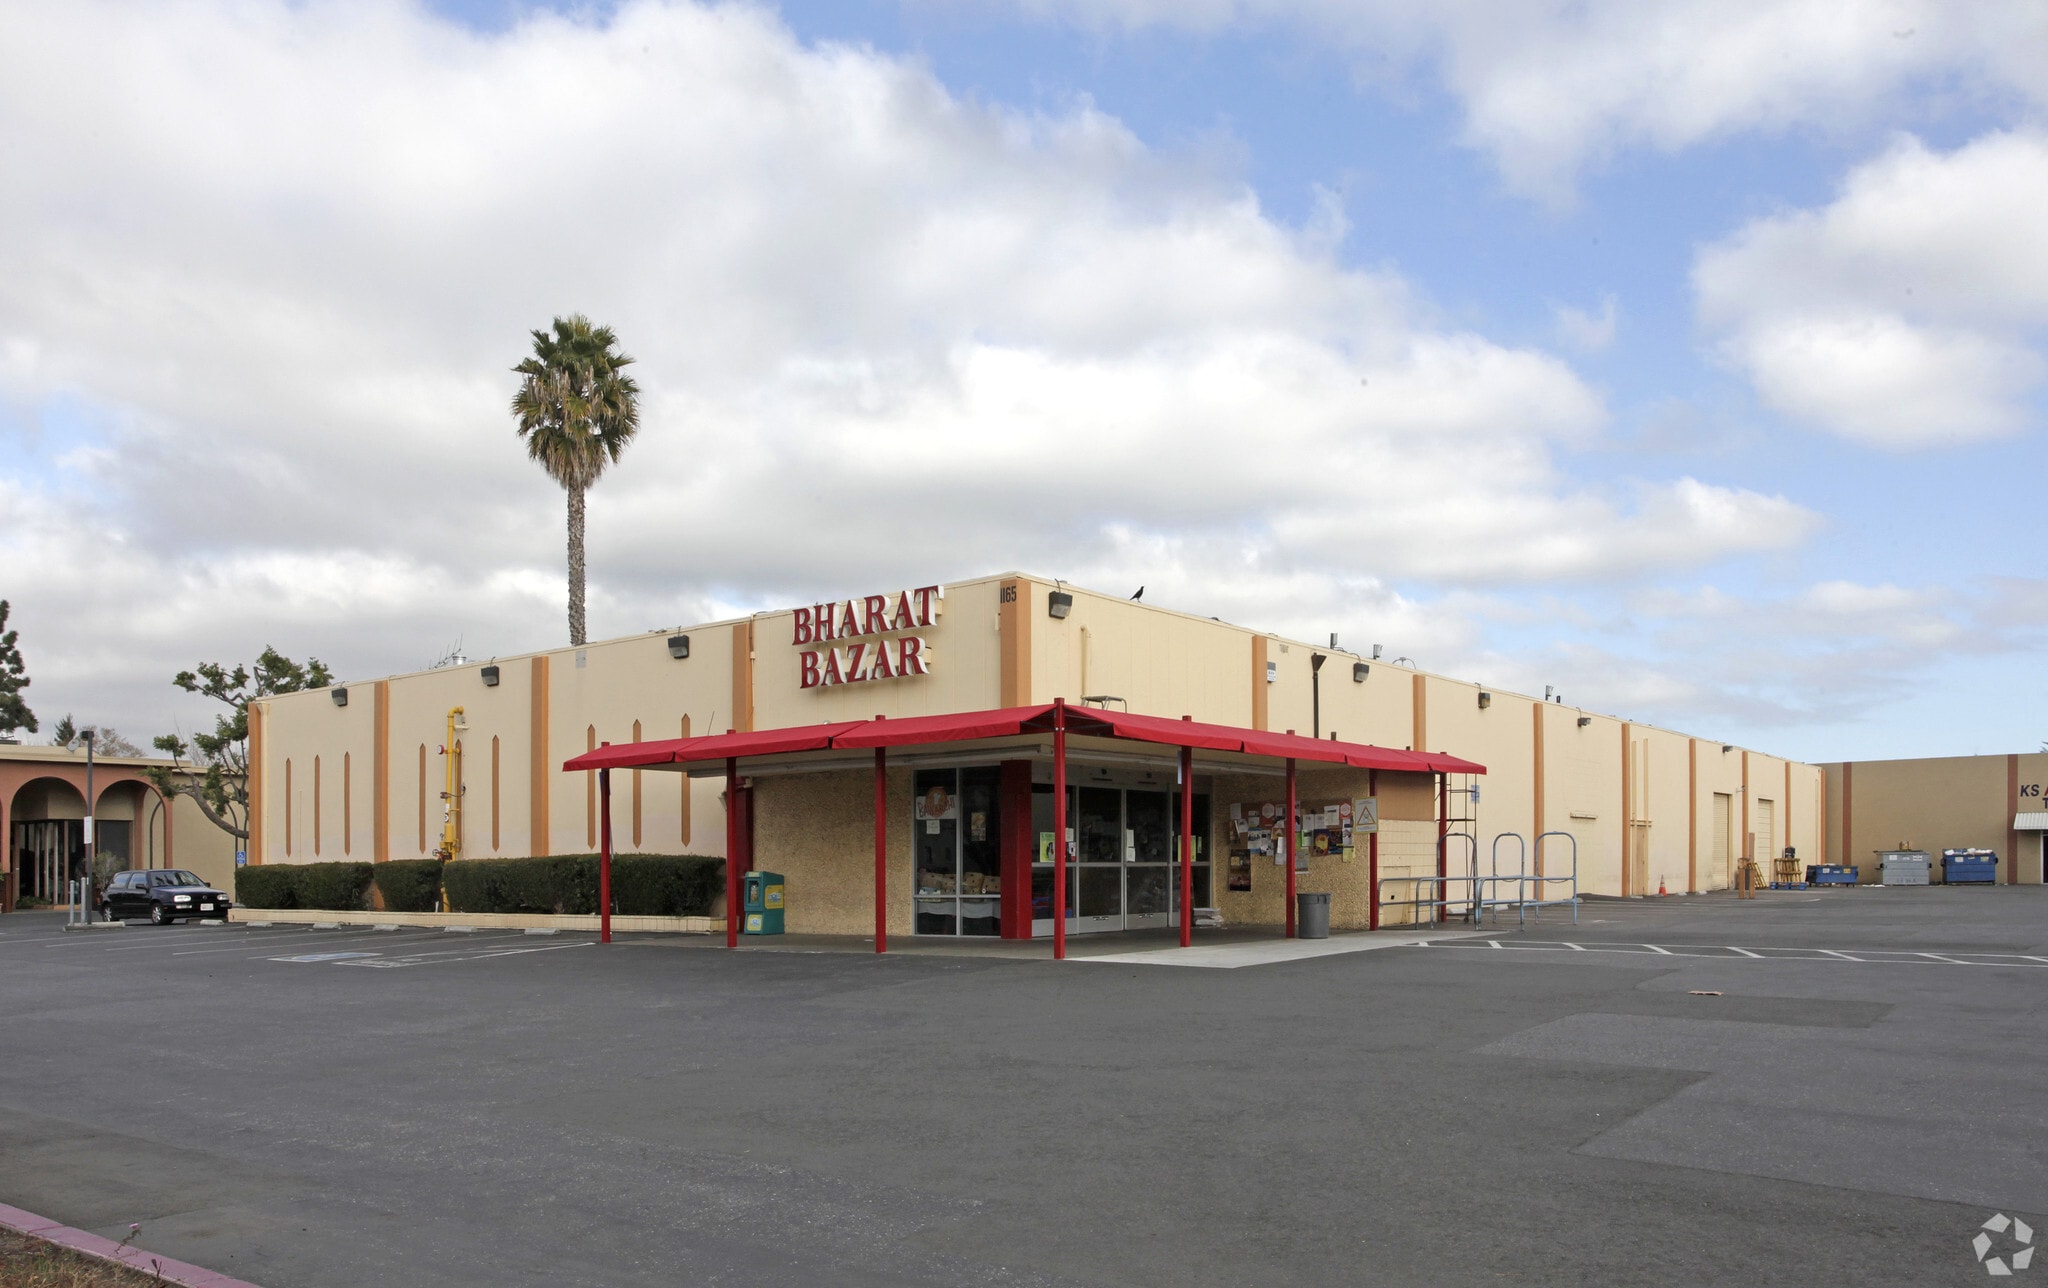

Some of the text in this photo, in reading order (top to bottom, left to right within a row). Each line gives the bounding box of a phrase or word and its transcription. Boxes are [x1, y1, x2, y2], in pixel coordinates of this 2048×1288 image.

[999, 585, 1017, 604] 1165
[791, 585, 943, 646] BHARAT
[799, 636, 929, 689] BAZAR
[2020, 784, 2040, 797] KS
